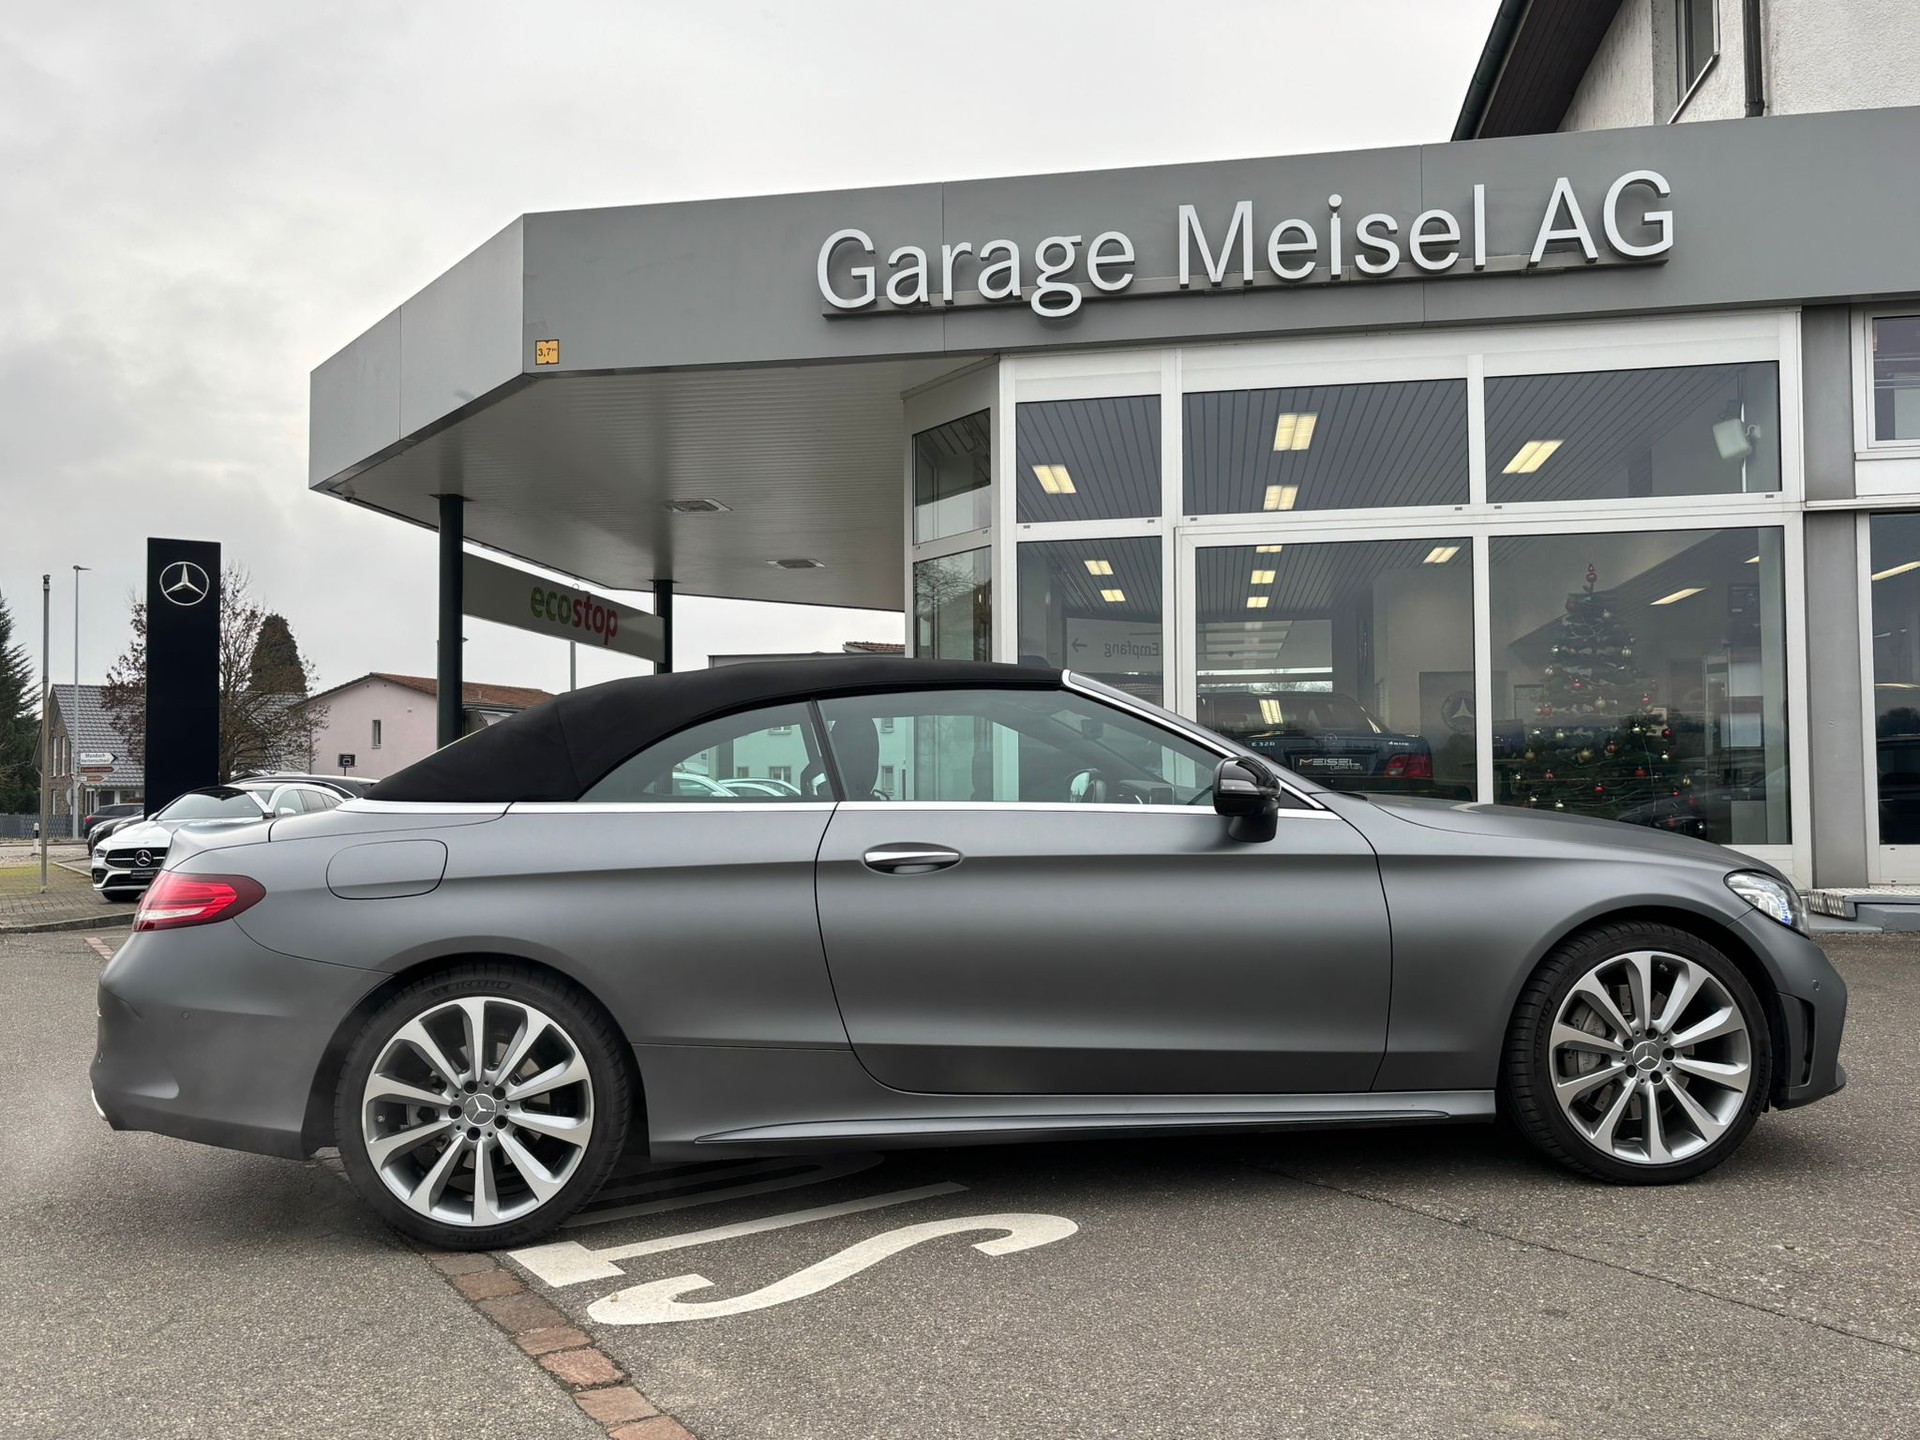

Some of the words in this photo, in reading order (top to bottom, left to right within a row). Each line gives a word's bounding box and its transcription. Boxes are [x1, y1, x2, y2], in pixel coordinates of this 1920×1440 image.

[816, 228, 1137, 319] Garage
[1176, 184, 1488, 289] Meisel
[1528, 169, 1674, 271] AG
[529, 586, 619, 645] ecostop
[1299, 758, 1361, 766] MEISEL
